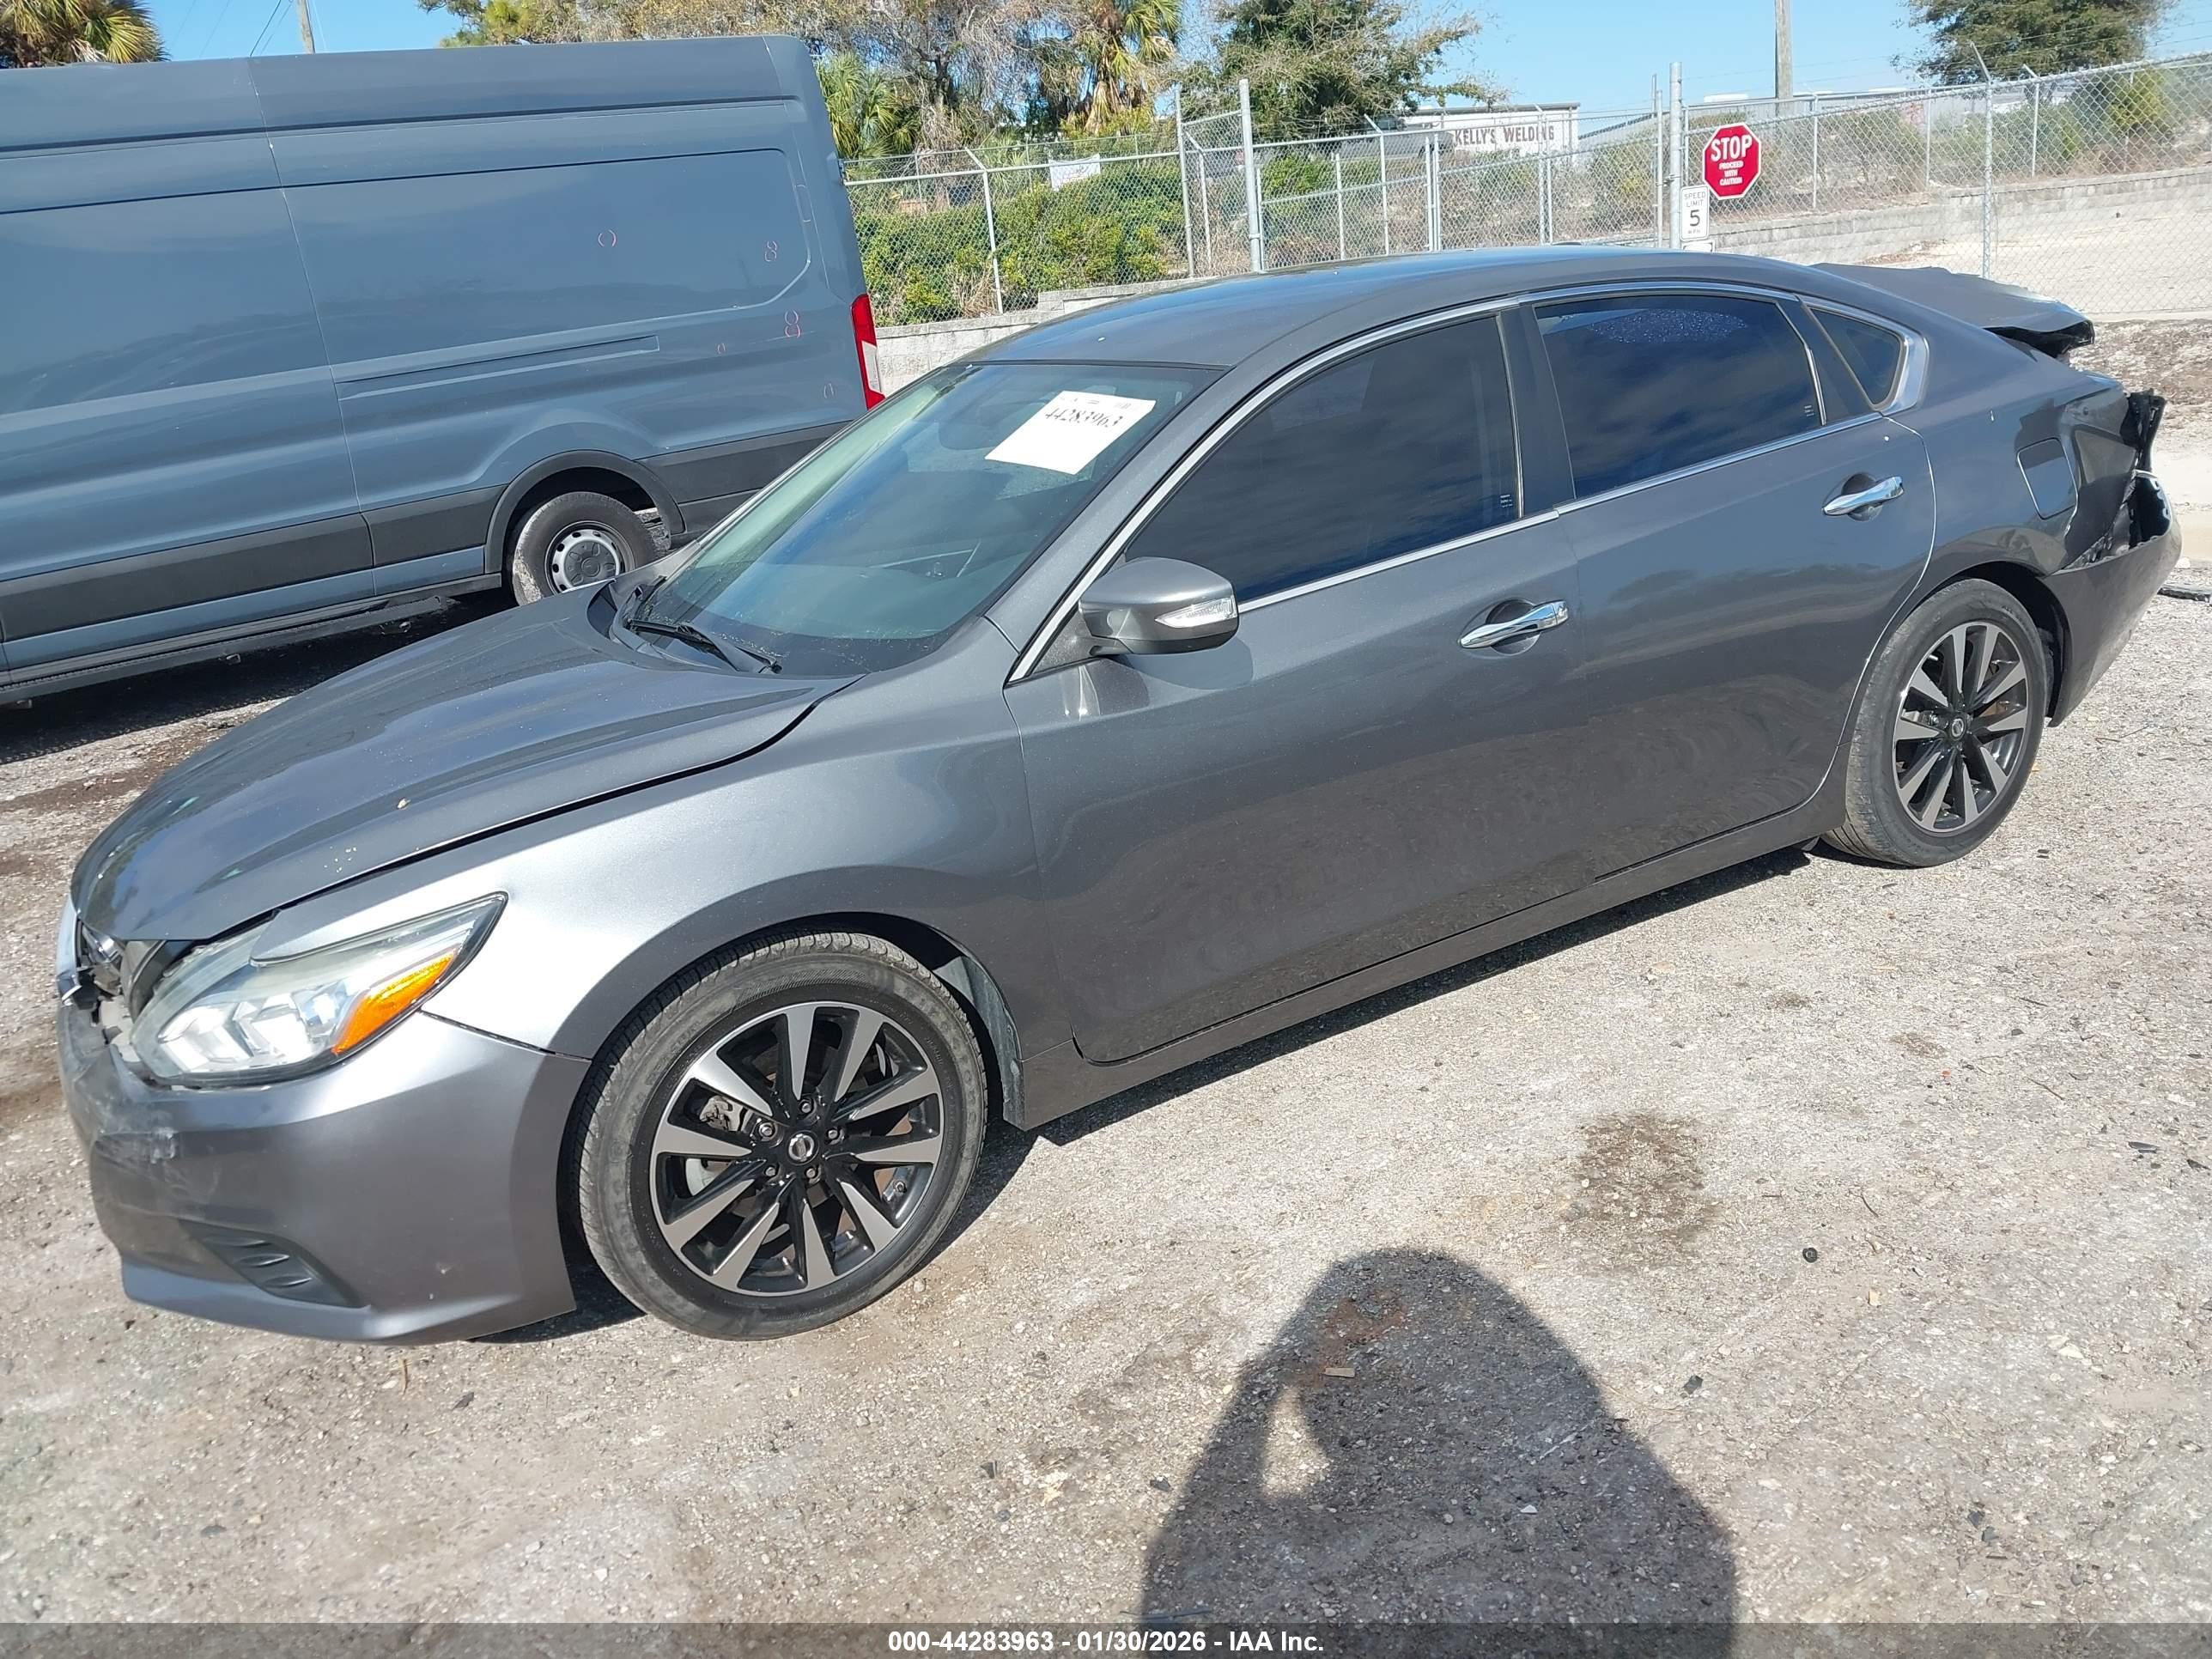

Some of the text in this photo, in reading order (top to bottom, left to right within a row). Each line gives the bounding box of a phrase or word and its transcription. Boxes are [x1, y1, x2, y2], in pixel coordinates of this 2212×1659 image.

[1455, 125, 1554, 145] KELLY'S WELDING
[1711, 135, 1753, 161] STOP
[1719, 161, 1744, 170] PROCEED
[1719, 177, 1743, 185] CAUTION
[1684, 191, 1706, 200] SPEED
[1690, 210, 1700, 227] 5
[1045, 407, 1124, 428] 44283963
